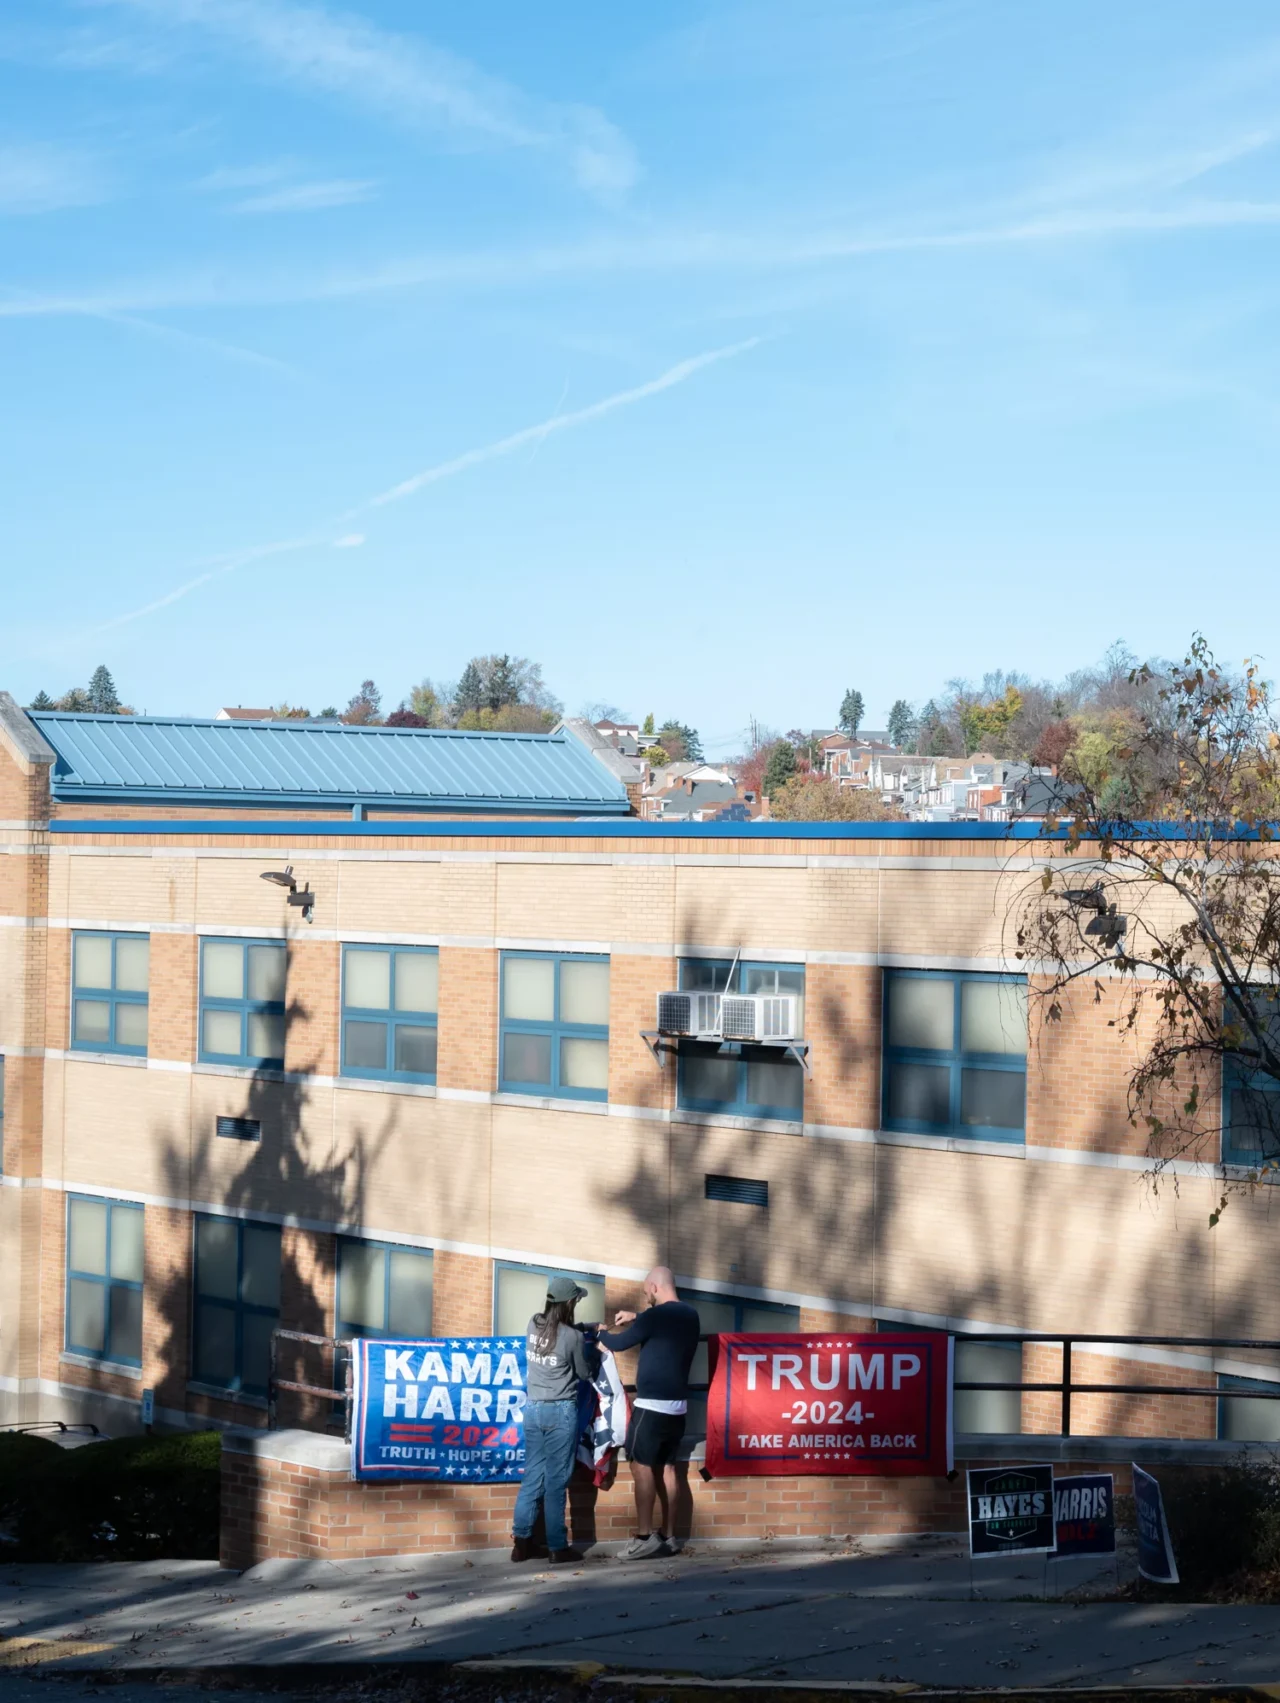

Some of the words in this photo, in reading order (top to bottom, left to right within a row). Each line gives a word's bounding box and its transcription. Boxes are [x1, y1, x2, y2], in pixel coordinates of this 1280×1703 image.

[384, 1349, 523, 1386] KAMA
[737, 1353, 921, 1391] TRUMP
[383, 1384, 526, 1423] HARR
[442, 1426, 519, 1447] 2024
[738, 1434, 783, 1448] TAKE
[788, 1434, 865, 1448] AMERICA
[870, 1434, 917, 1448] BACK
[379, 1446, 436, 1460] TRUTH
[448, 1449, 491, 1462] HOPE
[978, 1492, 1046, 1519] HAYES
